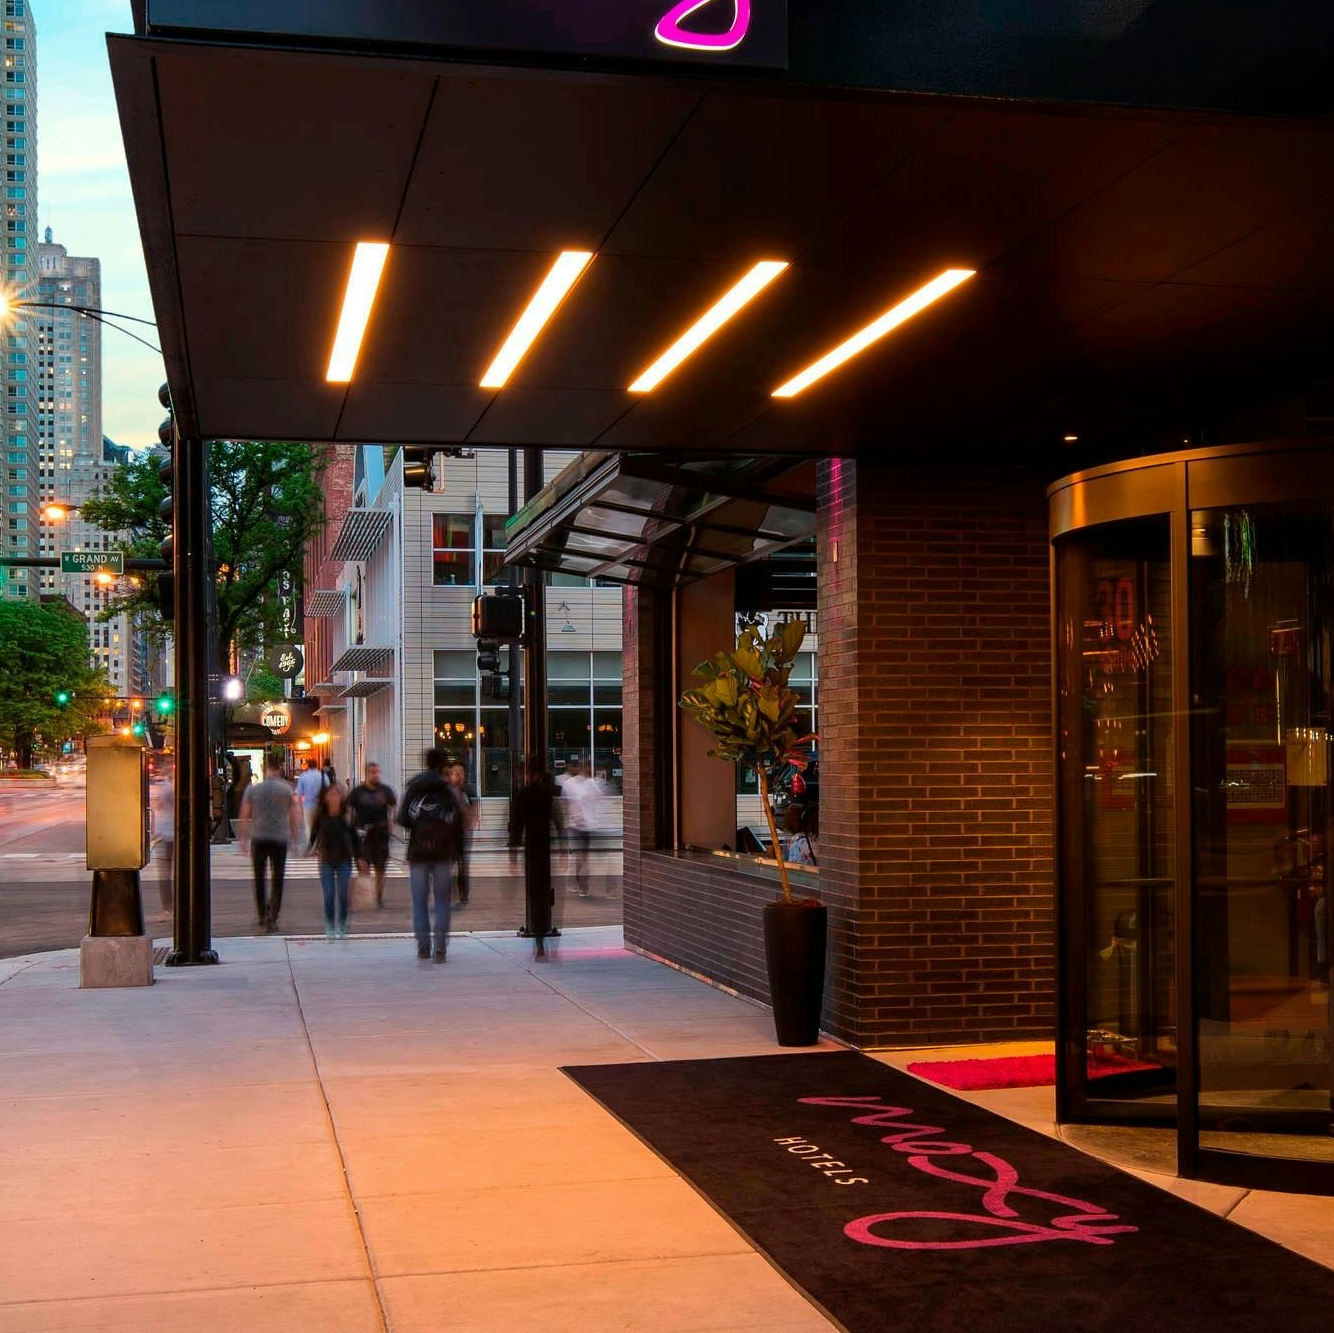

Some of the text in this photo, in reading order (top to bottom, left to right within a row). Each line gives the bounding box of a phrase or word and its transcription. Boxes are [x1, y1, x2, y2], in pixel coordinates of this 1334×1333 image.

[72, 554, 107, 563] GRAND
[262, 715, 288, 726] COMEDY
[773, 1136, 869, 1185] HOTELS
